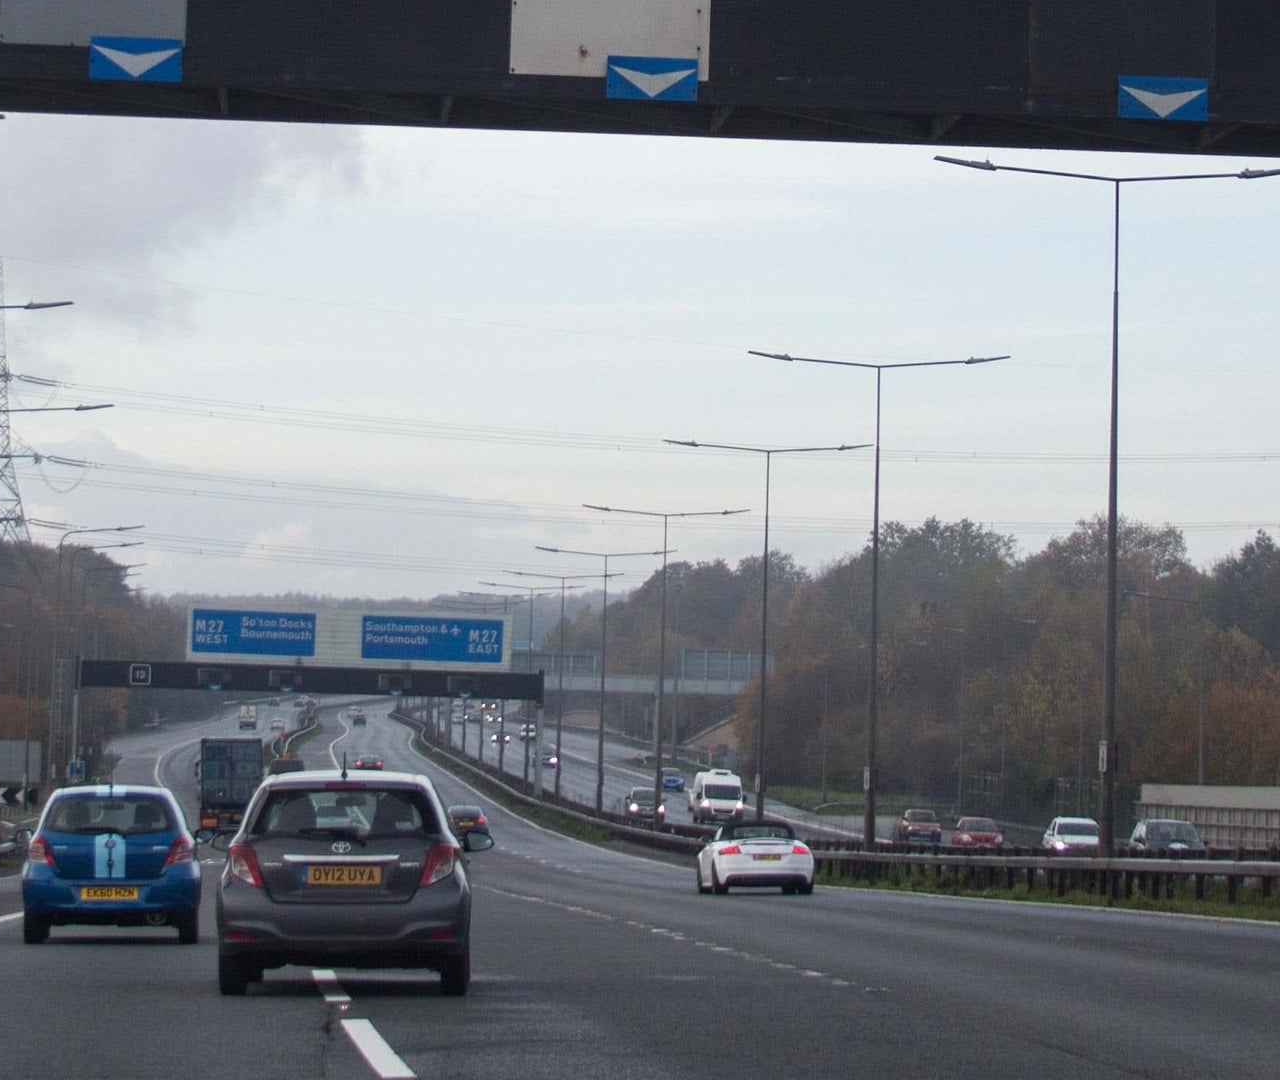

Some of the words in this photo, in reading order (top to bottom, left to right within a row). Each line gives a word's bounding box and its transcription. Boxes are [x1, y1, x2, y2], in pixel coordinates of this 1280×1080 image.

[196, 619, 225, 633] M27
[280, 617, 313, 629] Docks
[365, 620, 438, 635] Southampton
[196, 633, 229, 645] WEST
[241, 628, 312, 641] Bournemouth
[366, 633, 428, 645] Portsmouth
[469, 629, 498, 643] M27
[468, 643, 499, 654] EAST
